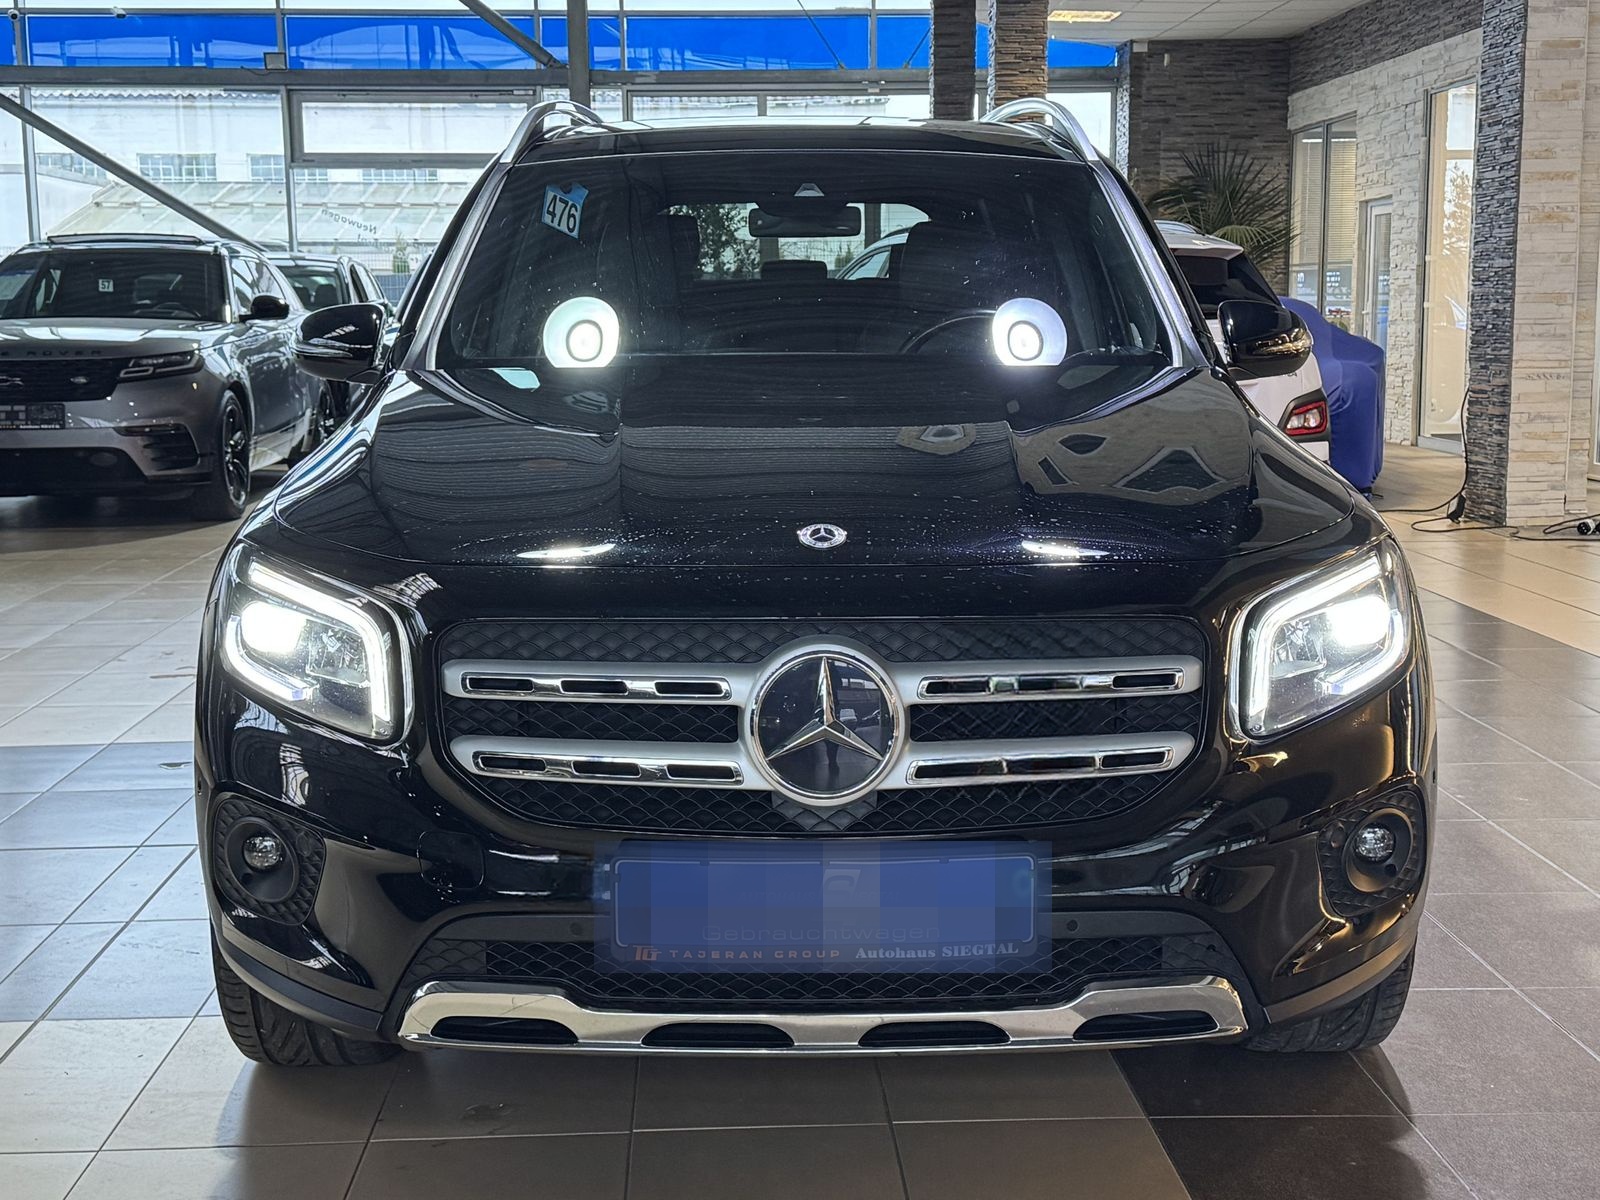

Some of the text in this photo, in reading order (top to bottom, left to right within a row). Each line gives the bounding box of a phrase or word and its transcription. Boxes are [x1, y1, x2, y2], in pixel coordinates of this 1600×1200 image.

[546, 194, 578, 234] 476
[101, 280, 111, 290] 57
[702, 925, 940, 943] Gebrauchtwagen
[669, 949, 763, 959] TAJERAN
[774, 949, 840, 959] GROUP
[855, 943, 1019, 959] Autohaus SIEGTAL
